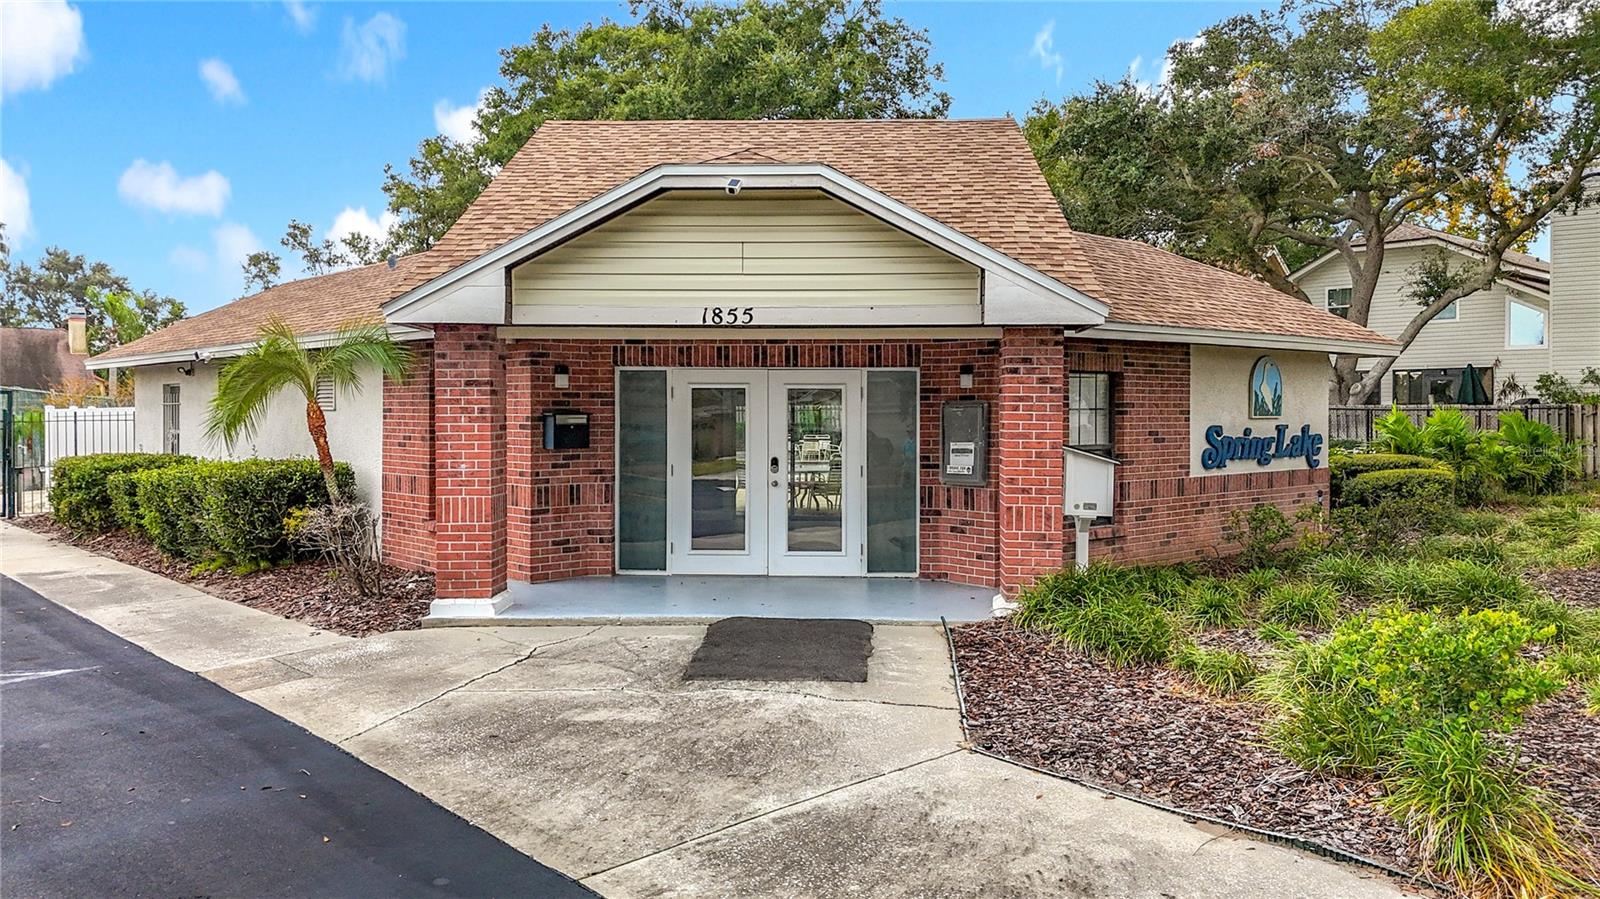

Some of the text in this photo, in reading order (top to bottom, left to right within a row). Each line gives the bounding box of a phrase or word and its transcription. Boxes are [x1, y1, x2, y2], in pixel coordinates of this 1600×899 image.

[702, 307, 754, 325] 1855
[1201, 424, 1323, 469] Spring Lake
